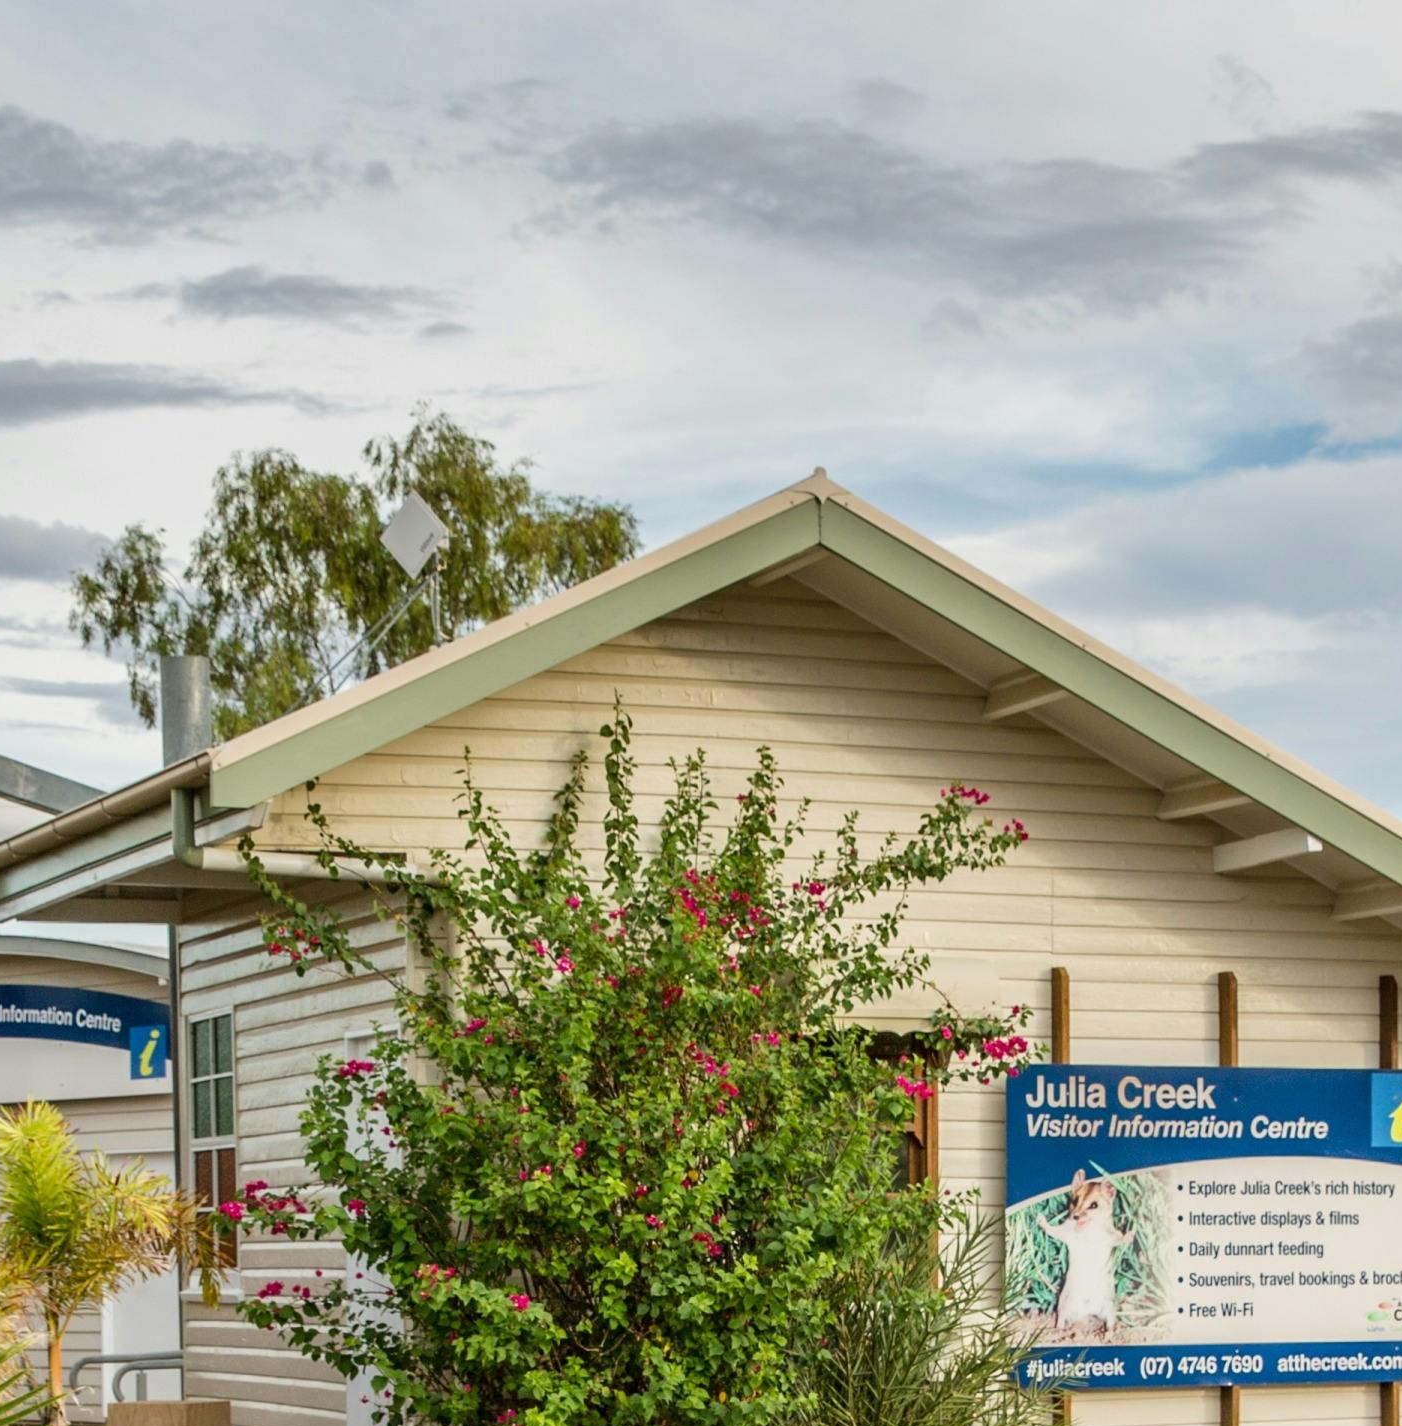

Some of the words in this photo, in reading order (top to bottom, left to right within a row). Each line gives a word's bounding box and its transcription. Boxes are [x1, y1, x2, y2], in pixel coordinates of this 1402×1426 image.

[76, 1008, 121, 1033] Centre
[1025, 1075, 1107, 1108] Julia
[1117, 1075, 1216, 1109] Creek
[1026, 1114, 1103, 1137] Visitor
[1108, 1114, 1243, 1138] Information
[1250, 1115, 1329, 1139] Centre
[1189, 1181, 1236, 1198] Explore
[1240, 1181, 1270, 1195] Julia
[1274, 1181, 1321, 1195] Creek's
[1325, 1181, 1348, 1195] rich
[1353, 1181, 1395, 1198] history
[1189, 1212, 1256, 1225] Interactive
[1260, 1211, 1311, 1228] displays
[1315, 1211, 1325, 1225] &
[1329, 1211, 1359, 1225] films
[1189, 1242, 1220, 1258] Daily
[1224, 1242, 1274, 1256] dunnart
[1278, 1242, 1324, 1258] feeding
[1189, 1272, 1255, 1288] Souvenirs,
[1260, 1272, 1294, 1285] travel
[1299, 1271, 1355, 1288] bookings
[1359, 1271, 1369, 1285] &
[1189, 1303, 1216, 1317] Free
[1221, 1302, 1254, 1317] Wi-Fi
[1026, 1357, 1125, 1382] #juliacreek
[1140, 1356, 1173, 1379] (07)
[1177, 1355, 1217, 1375] 4746
[1221, 1355, 1263, 1373] 7690
